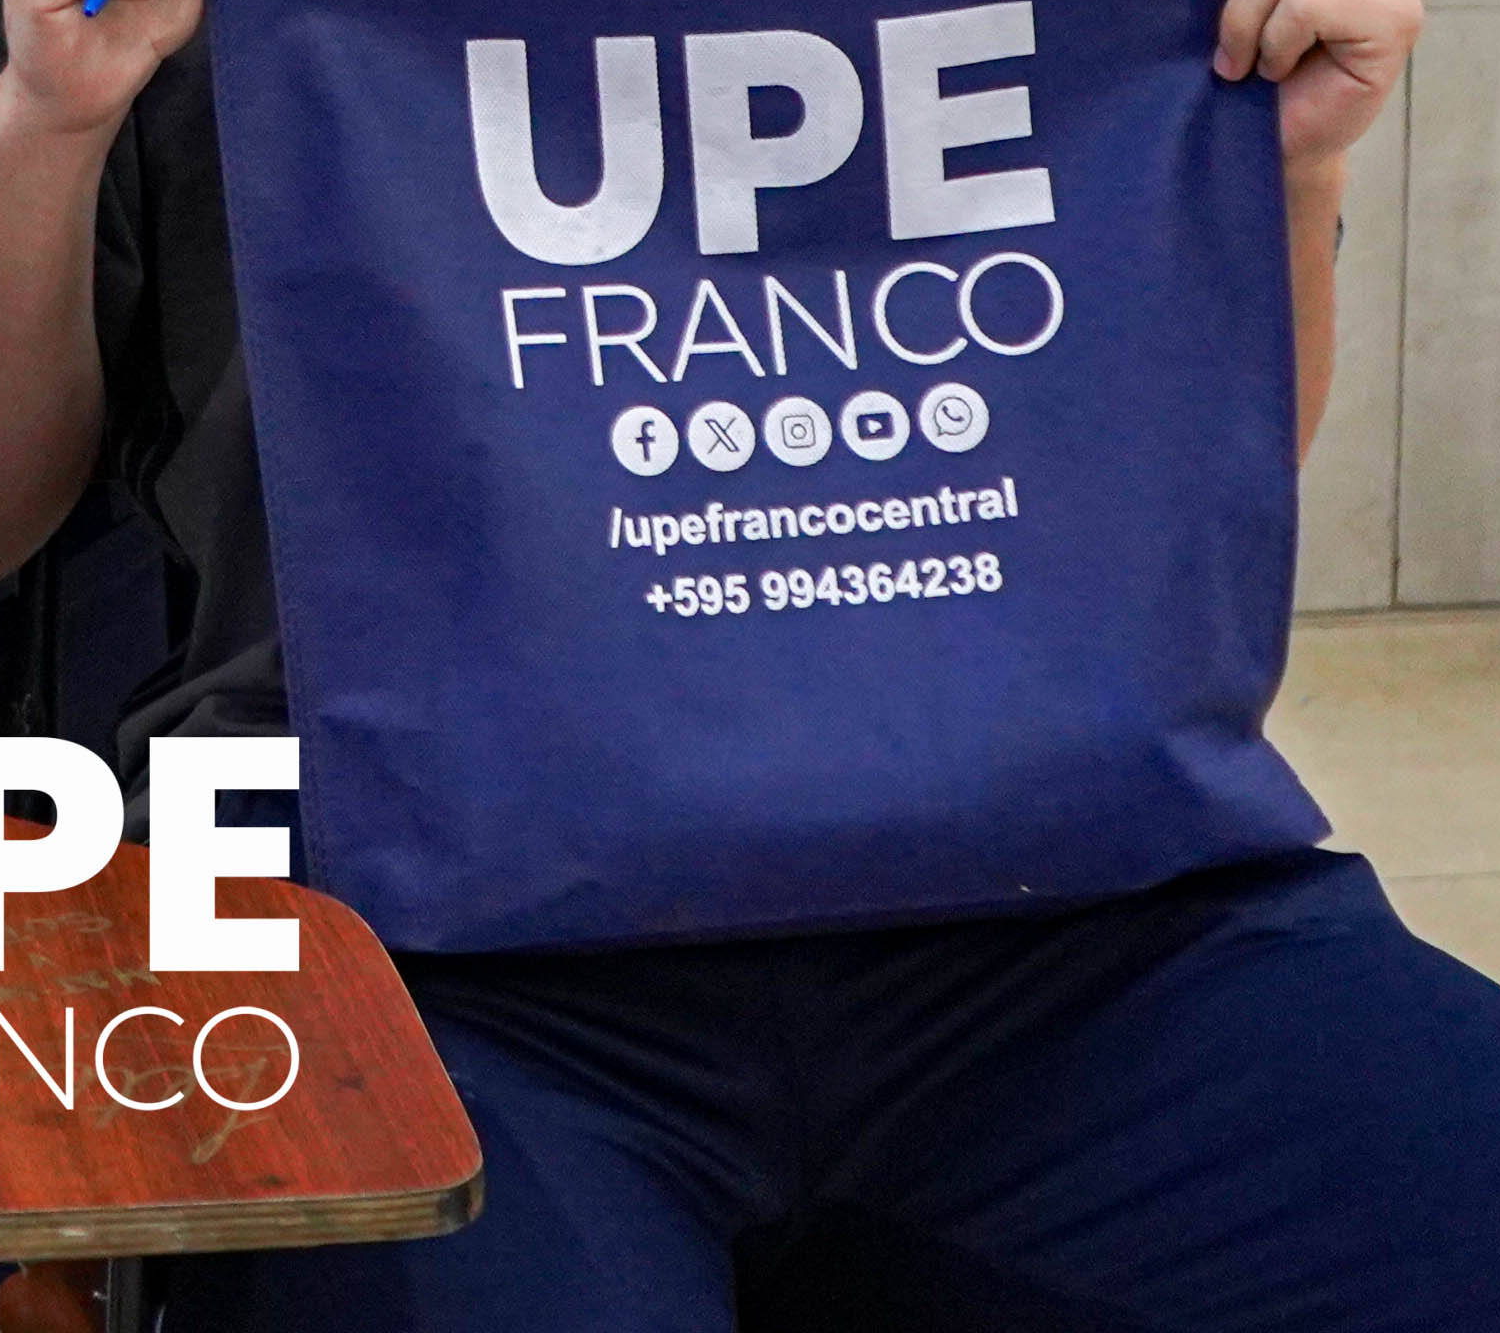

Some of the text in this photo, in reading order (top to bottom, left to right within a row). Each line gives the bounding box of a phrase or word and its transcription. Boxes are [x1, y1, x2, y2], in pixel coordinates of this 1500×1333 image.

[466, 0, 1055, 266] UPE
[502, 251, 1064, 390] FRANCO
[609, 477, 1019, 555] /upefrancocentral
[645, 551, 1004, 618] +595 994364238
